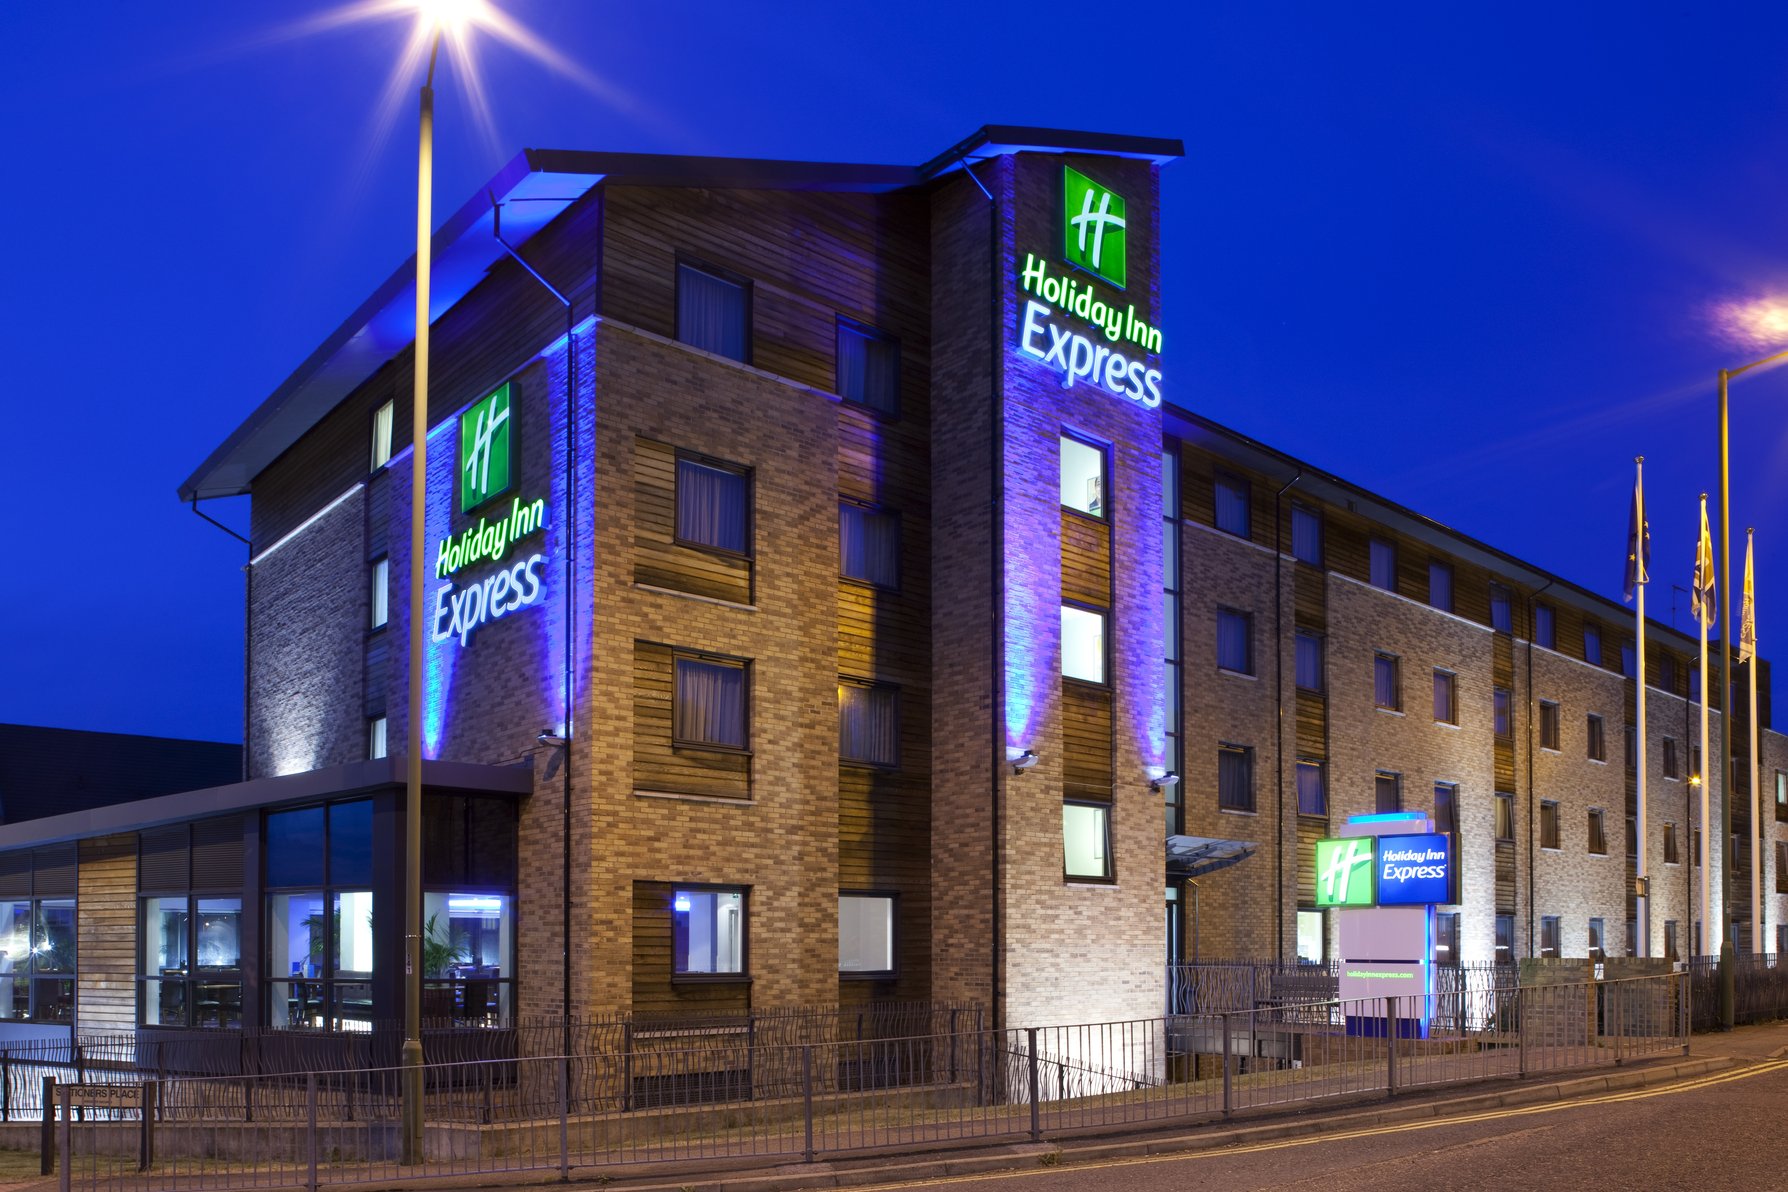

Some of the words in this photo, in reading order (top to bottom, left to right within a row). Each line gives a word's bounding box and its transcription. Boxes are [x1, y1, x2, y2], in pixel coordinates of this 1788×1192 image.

[1021, 253, 1123, 342] Holiday
[1125, 304, 1163, 354] Inn
[1021, 300, 1163, 408] Express
[435, 517, 509, 580] Holiday
[509, 497, 544, 543] Inn
[432, 553, 543, 647] Express
[1383, 849, 1425, 863] Holiday
[1426, 848, 1445, 860] Inn
[1383, 864, 1446, 883] Express
[1346, 970, 1414, 979] holidayinnexpress.com
[56, 1087, 107, 1098] STIONERS
[110, 1089, 140, 1099] PLACE
